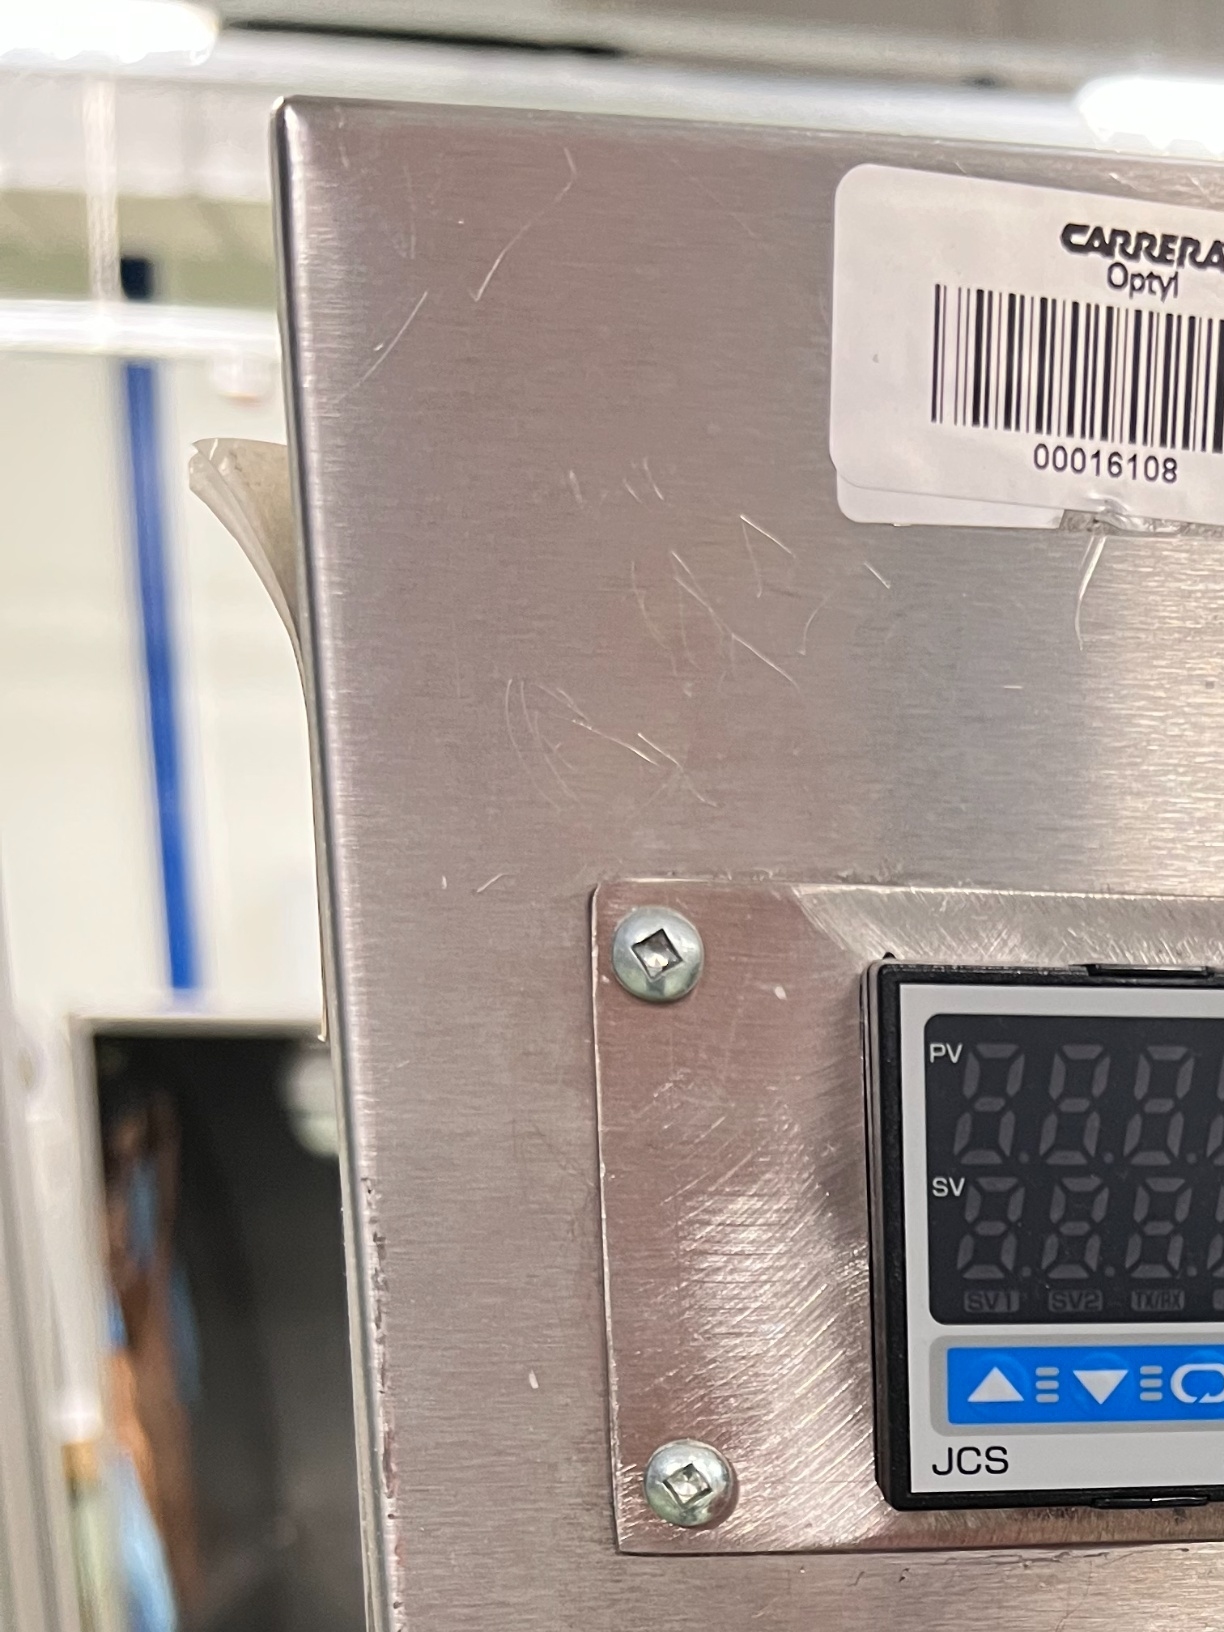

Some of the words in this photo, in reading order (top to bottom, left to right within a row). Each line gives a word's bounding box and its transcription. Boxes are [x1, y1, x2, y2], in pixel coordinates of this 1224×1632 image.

[1106, 262, 1179, 303] Optyl
[1033, 443, 1179, 484] 00016108
[929, 1043, 963, 1064] PV
[931, 1177, 966, 1197] SV
[967, 1292, 1014, 1311] SV1
[1051, 1291, 1101, 1311] SV2
[931, 1445, 1010, 1476] JCS
